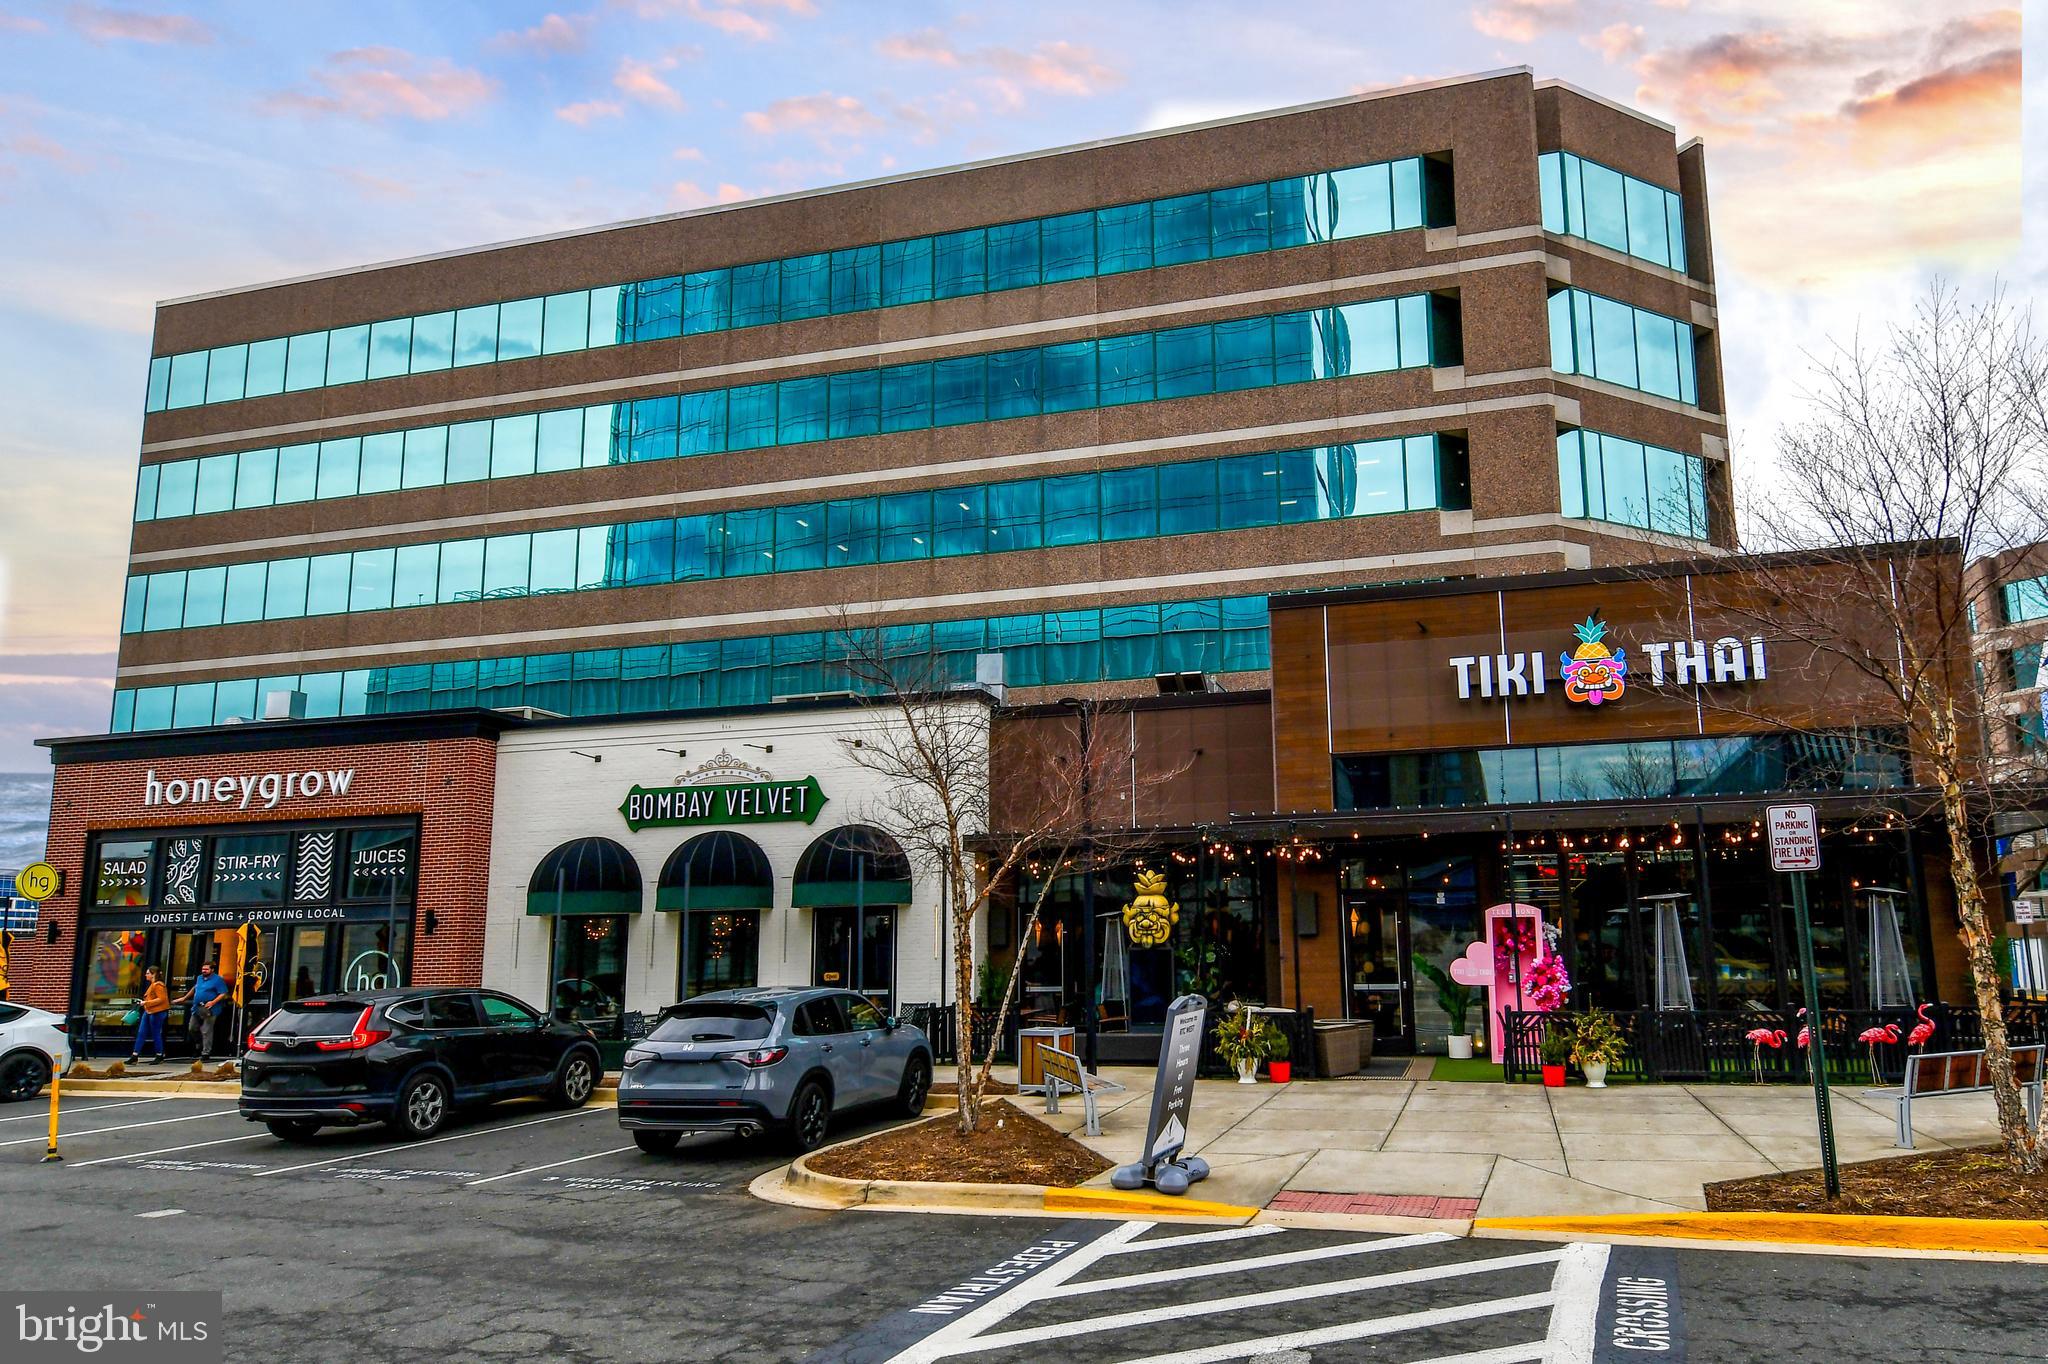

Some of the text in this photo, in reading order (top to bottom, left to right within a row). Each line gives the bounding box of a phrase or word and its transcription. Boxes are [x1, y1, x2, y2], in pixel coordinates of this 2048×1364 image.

[1448, 635, 1768, 700] TIKI THAI
[144, 768, 355, 809] honeygrow
[629, 786, 809, 821] BOMBAY VELVET
[1785, 810, 1796, 819] NO
[1775, 820, 1809, 830] PARKING
[1774, 836, 1813, 846] STANDING
[354, 849, 406, 865] JUICES
[1774, 846, 1816, 858] FIRE LANE
[103, 861, 147, 875] SALAD
[217, 854, 281, 870] STIR-FRY
[29, 871, 49, 892] hg
[143, 912, 188, 924] HONEST
[192, 911, 234, 922] EATING
[247, 909, 303, 920] GROWING
[307, 908, 346, 919] LOCAL
[1173, 1085, 1183, 1095] Free
[1168, 1097, 1184, 1112] Parking
[909, 1240, 1080, 1315] PEDESTRIAN
[1611, 1276, 1671, 1352] CROSSING
